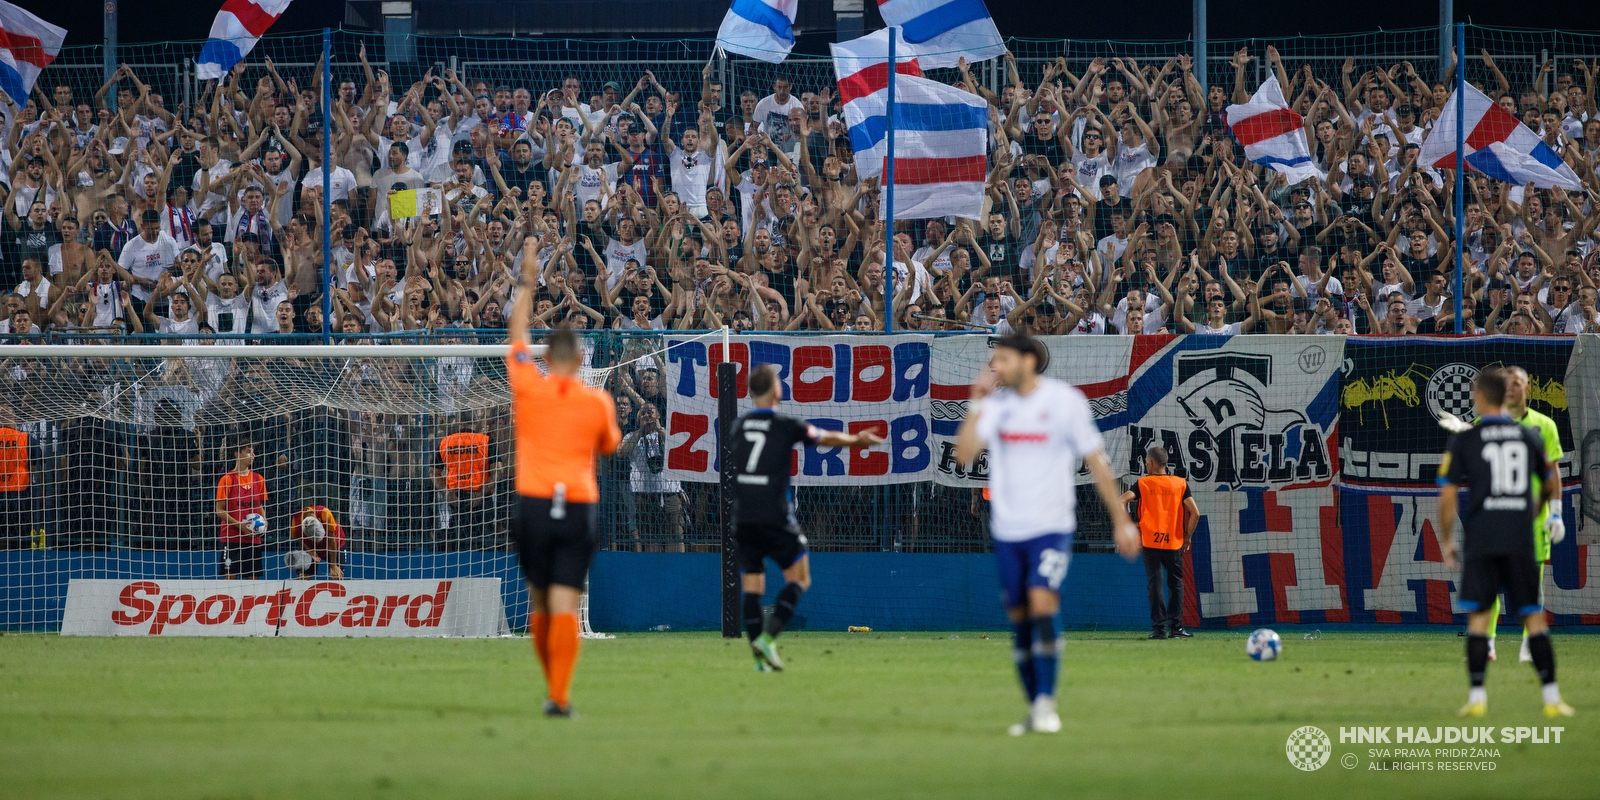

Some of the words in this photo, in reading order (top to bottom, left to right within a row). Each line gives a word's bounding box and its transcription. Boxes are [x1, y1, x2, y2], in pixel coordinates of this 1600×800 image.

[667, 339, 932, 404] TORCIDA
[1302, 352, 1322, 369] VII
[1432, 366, 1477, 386] HAJDU
[667, 411, 932, 478] ZREB
[743, 431, 767, 473] 7
[1481, 440, 1529, 497] 18
[1153, 532, 1170, 544] 274
[111, 581, 453, 635] SportCard
